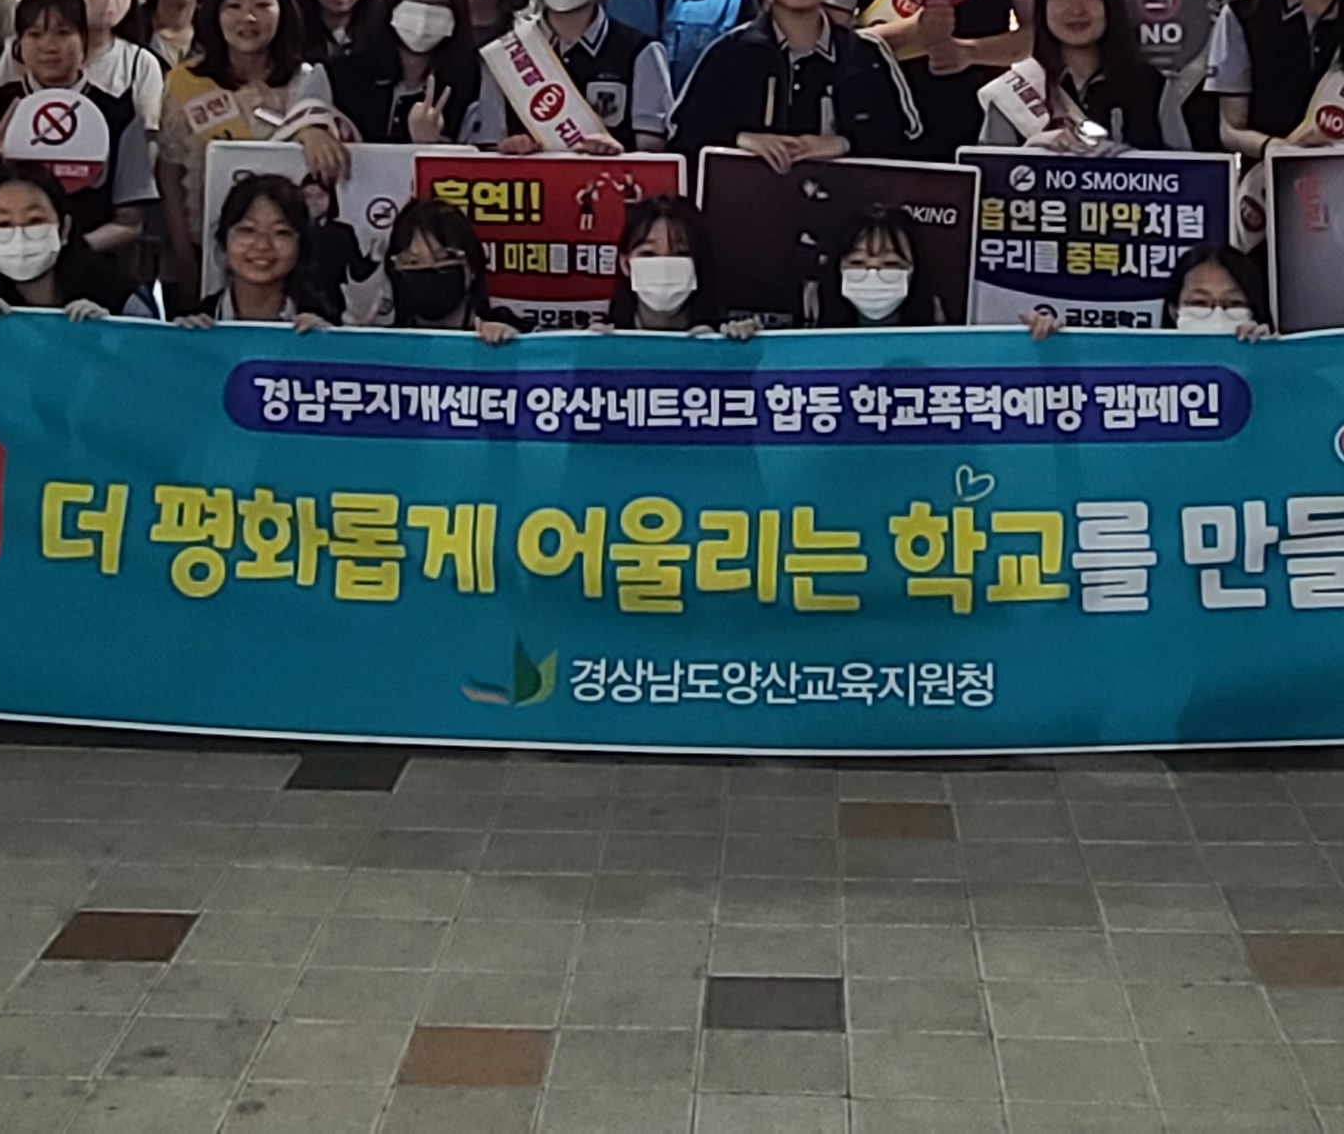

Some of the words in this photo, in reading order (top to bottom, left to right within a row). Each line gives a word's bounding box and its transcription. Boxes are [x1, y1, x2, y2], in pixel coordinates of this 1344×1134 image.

[1140, 23, 1182, 44] NO
[533, 86, 563, 118] NO!
[1046, 170, 1076, 189] NO
[1081, 171, 1180, 193] SMOKING
[900, 203, 960, 226] KING
[980, 197, 1068, 234] 흡연은
[1079, 201, 1205, 239] 마약처럼
[503, 243, 569, 274] 미래를
[979, 238, 1059, 273] 우리를
[253, 377, 518, 428] 경남무지개센터
[526, 385, 758, 432] 양산네트워크
[765, 384, 843, 434] 합동
[850, 383, 1086, 433] 학교폭력예방
[1095, 382, 1221, 431] 캠페인
[40, 481, 130, 576] 더
[149, 484, 497, 602] 평화롭게
[517, 496, 869, 615] 어울리는
[888, 500, 1158, 615] 학교를
[569, 657, 997, 708] 경상남도양산교육지원청
